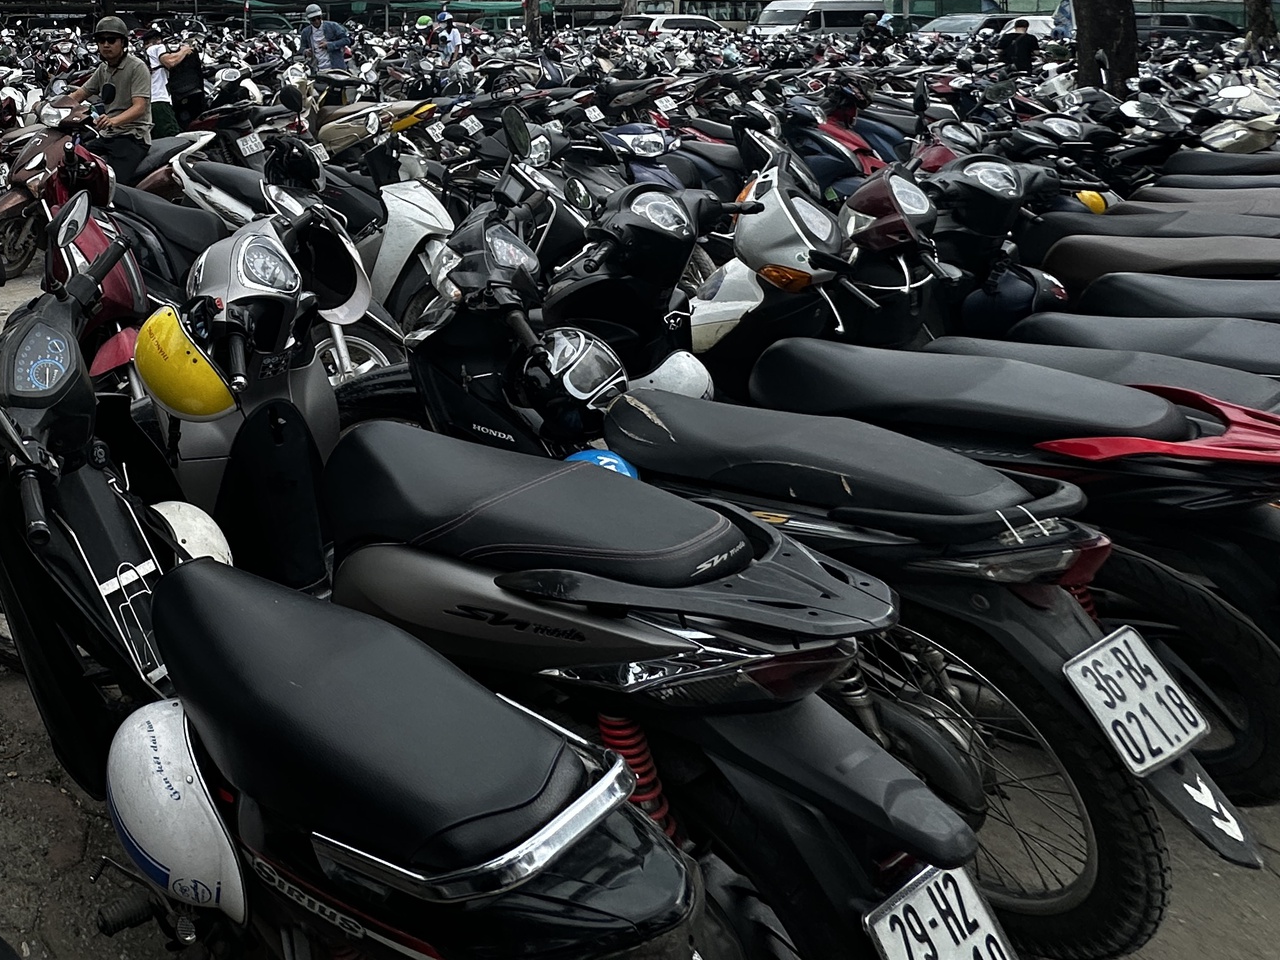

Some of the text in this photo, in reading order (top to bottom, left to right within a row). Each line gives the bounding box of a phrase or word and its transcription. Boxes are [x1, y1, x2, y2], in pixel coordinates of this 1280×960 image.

[472, 423, 516, 443] HONDA
[1081, 639, 1158, 710] 36-B4
[1111, 684, 1199, 765] 021.18
[252, 855, 366, 939] SIRIUS
[888, 872, 980, 960] 29-H2
